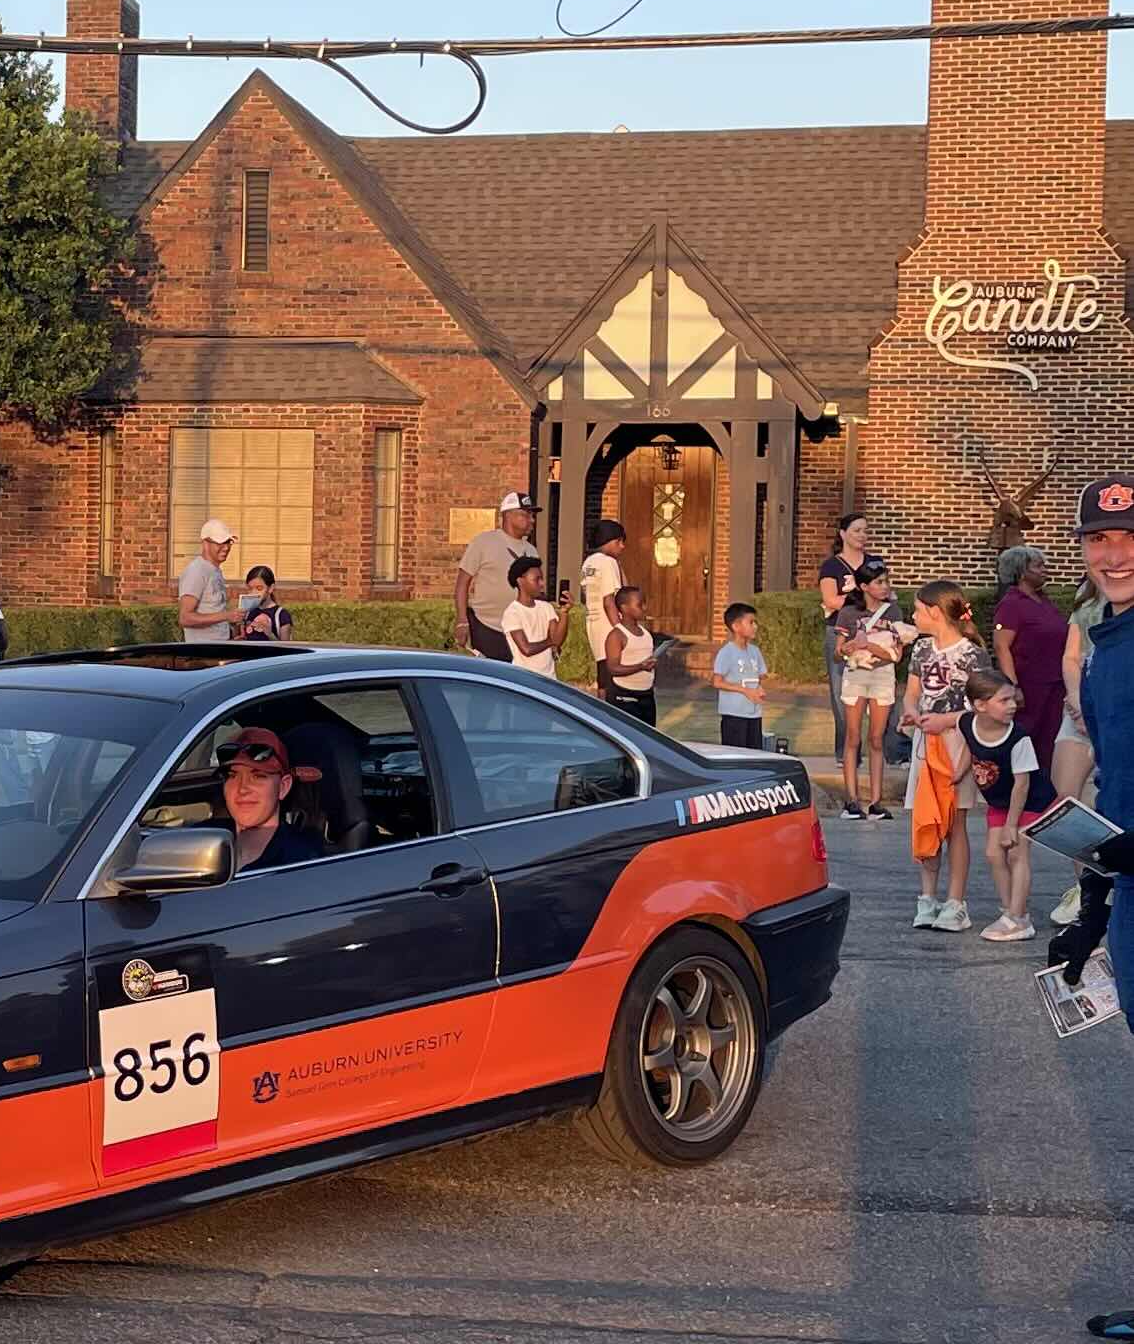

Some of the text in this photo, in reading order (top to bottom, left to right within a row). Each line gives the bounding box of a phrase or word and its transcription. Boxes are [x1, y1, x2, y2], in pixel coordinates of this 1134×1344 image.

[975, 286, 1036, 299] AUBURN
[925, 259, 1104, 390] Candle
[1007, 334, 1079, 348] COMPANY
[113, 1032, 211, 1102] 856
[288, 1030, 465, 1081] AUBURN UNIVERSITY
